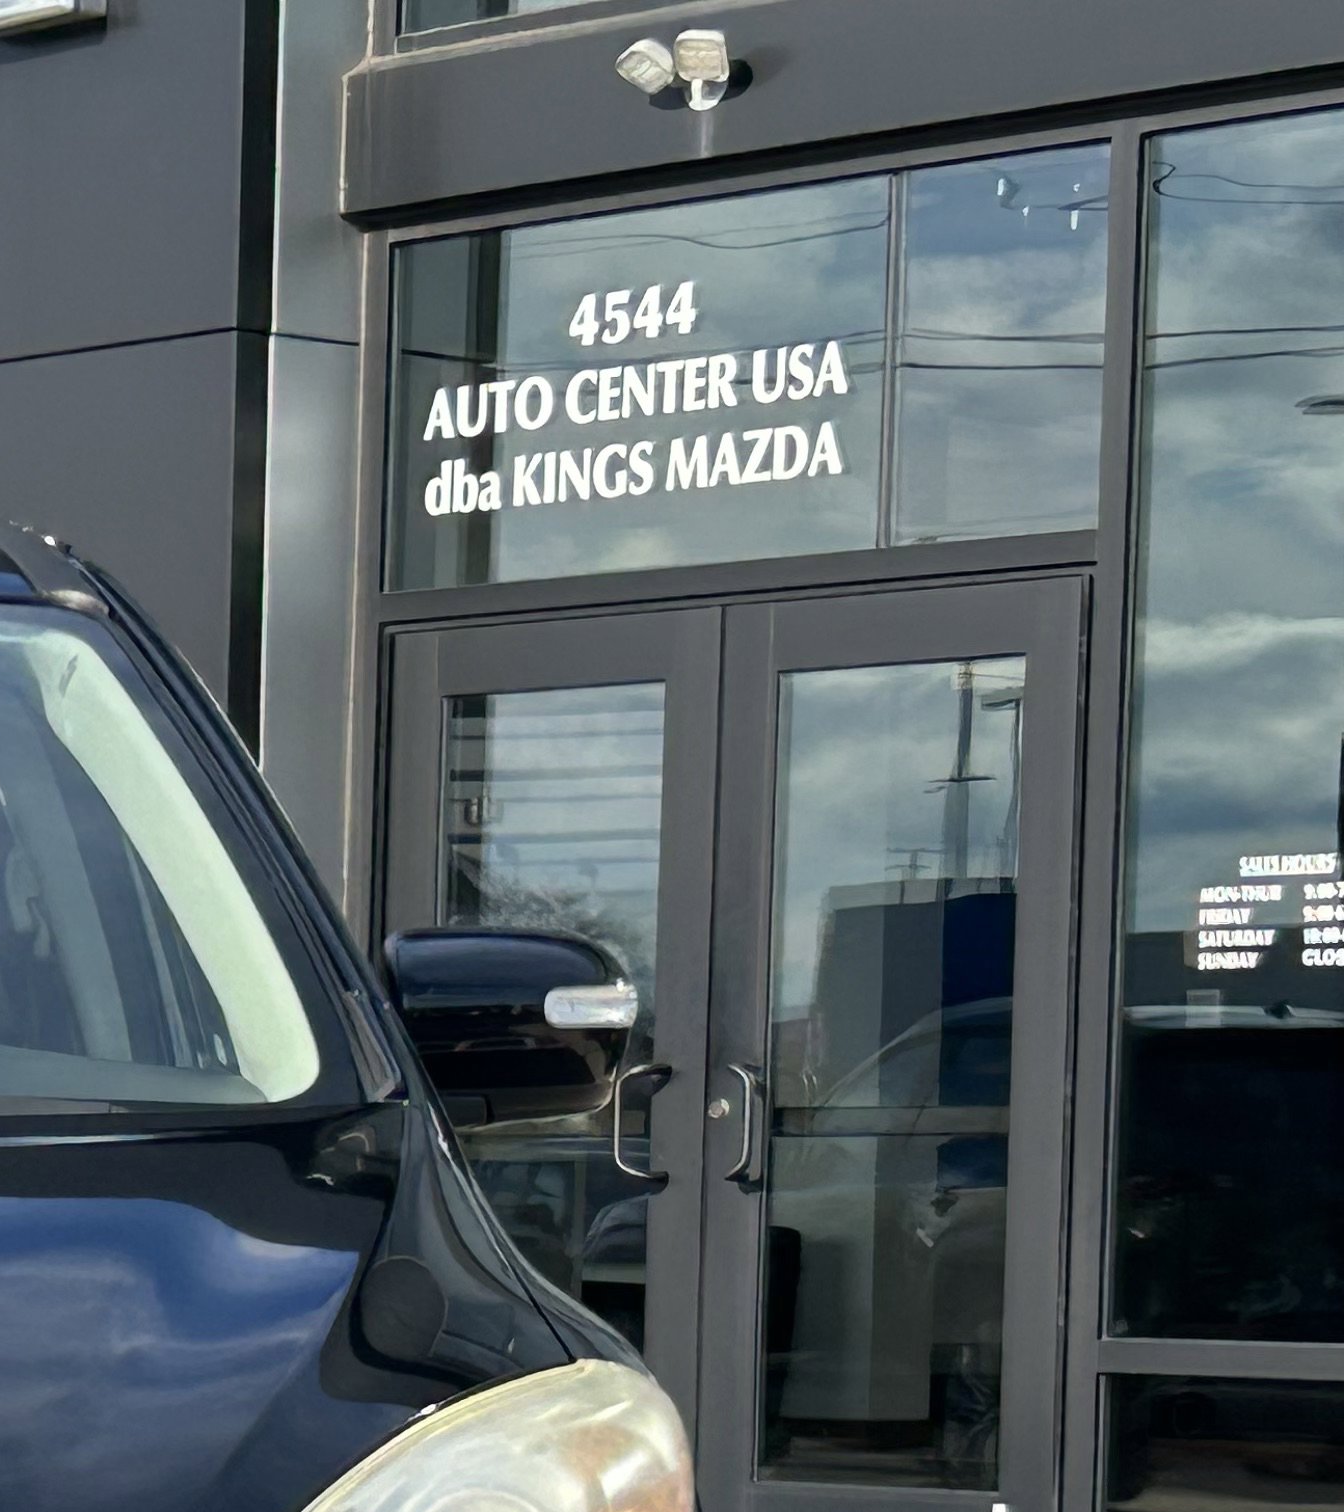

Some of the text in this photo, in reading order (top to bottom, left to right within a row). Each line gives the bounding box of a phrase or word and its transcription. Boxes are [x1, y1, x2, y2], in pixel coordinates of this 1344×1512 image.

[568, 280, 697, 346] 4544
[423, 340, 849, 441] AUTO CENTER USA
[424, 420, 844, 518] dba KINGS MAZDA
[1239, 852, 1338, 874] SALES HOURS
[1198, 907, 1251, 926] FRIDAY
[1198, 929, 1276, 948] SATURDAY
[1197, 951, 1260, 971] SUNDAY
